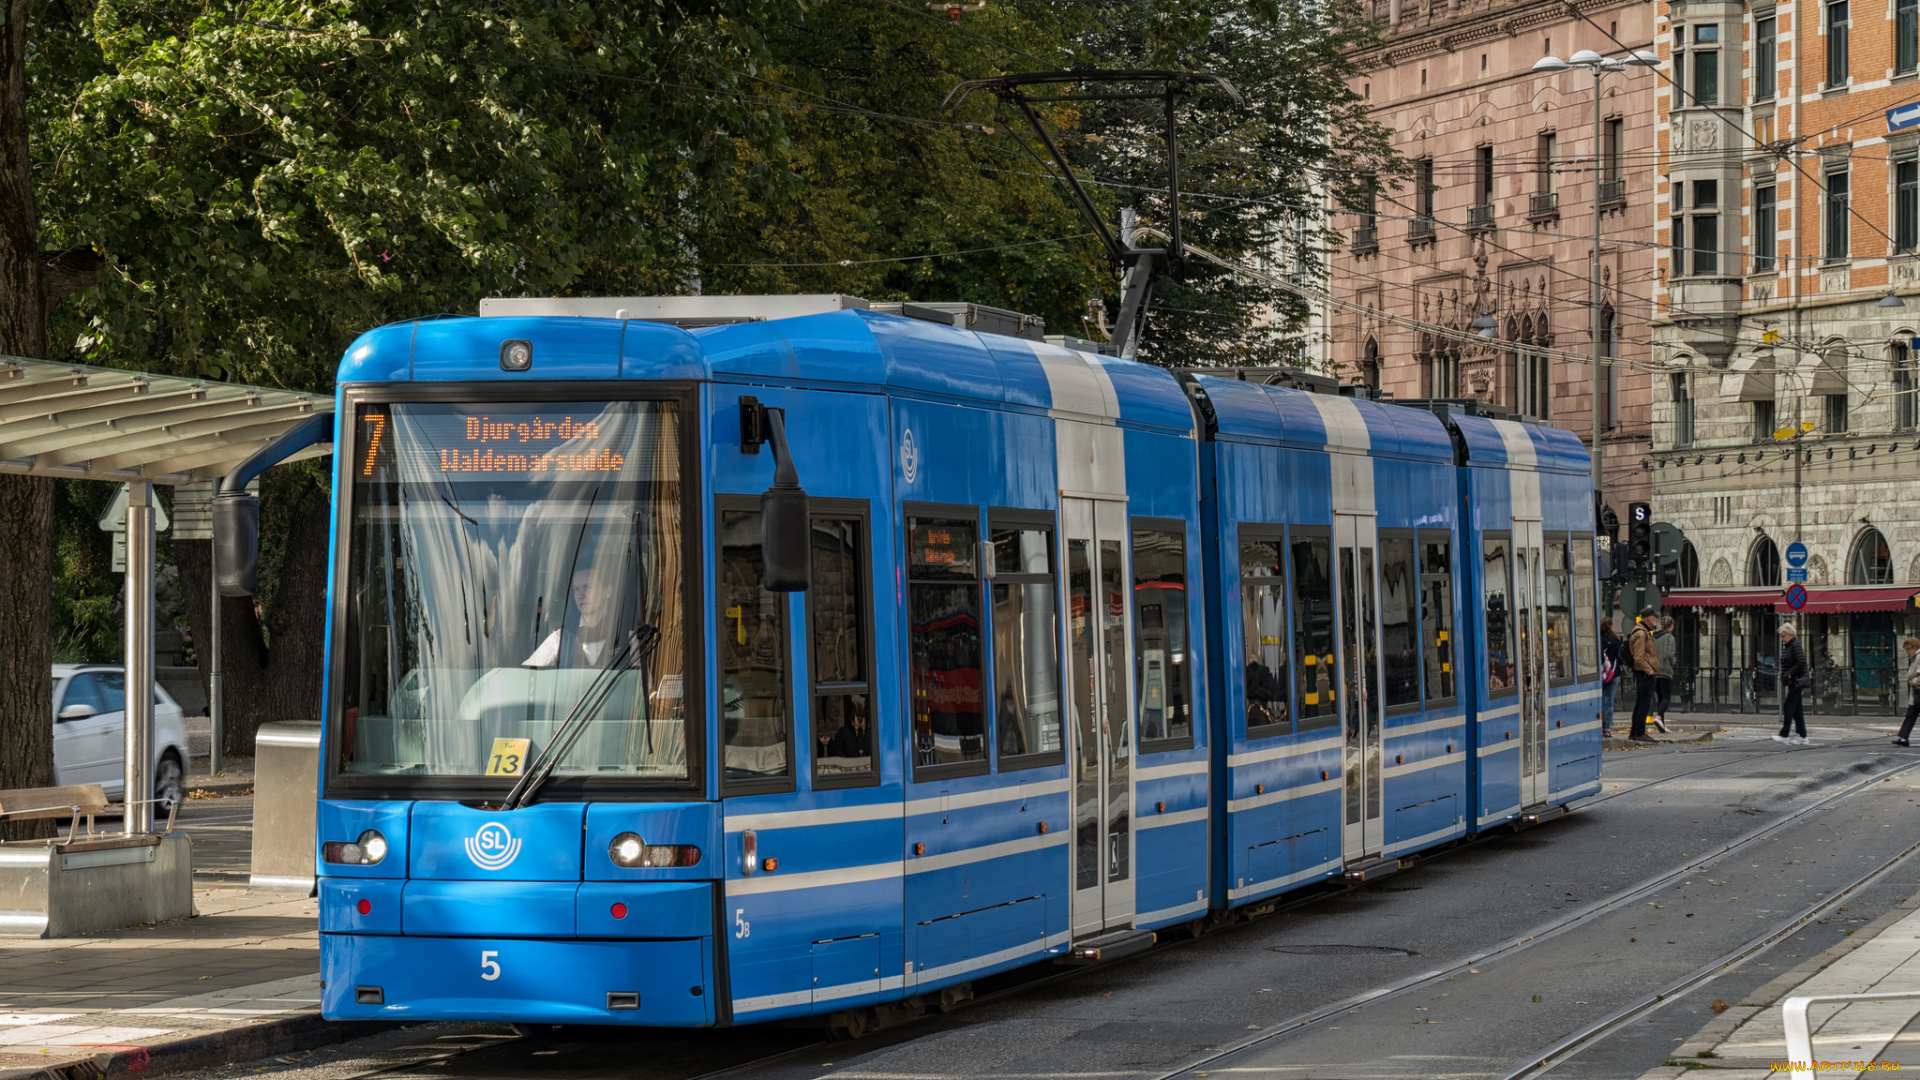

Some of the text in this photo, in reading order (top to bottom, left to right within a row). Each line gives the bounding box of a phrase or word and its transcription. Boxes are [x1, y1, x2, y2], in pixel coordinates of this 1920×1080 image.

[466, 416, 600, 443] Djurgården
[364, 414, 385, 476] 7
[441, 448, 624, 472] Waldemarsudde
[1635, 507, 1645, 521] S
[493, 754, 520, 774] 13
[481, 830, 505, 849] SL
[735, 908, 750, 939] 5B
[481, 950, 501, 981] 5
